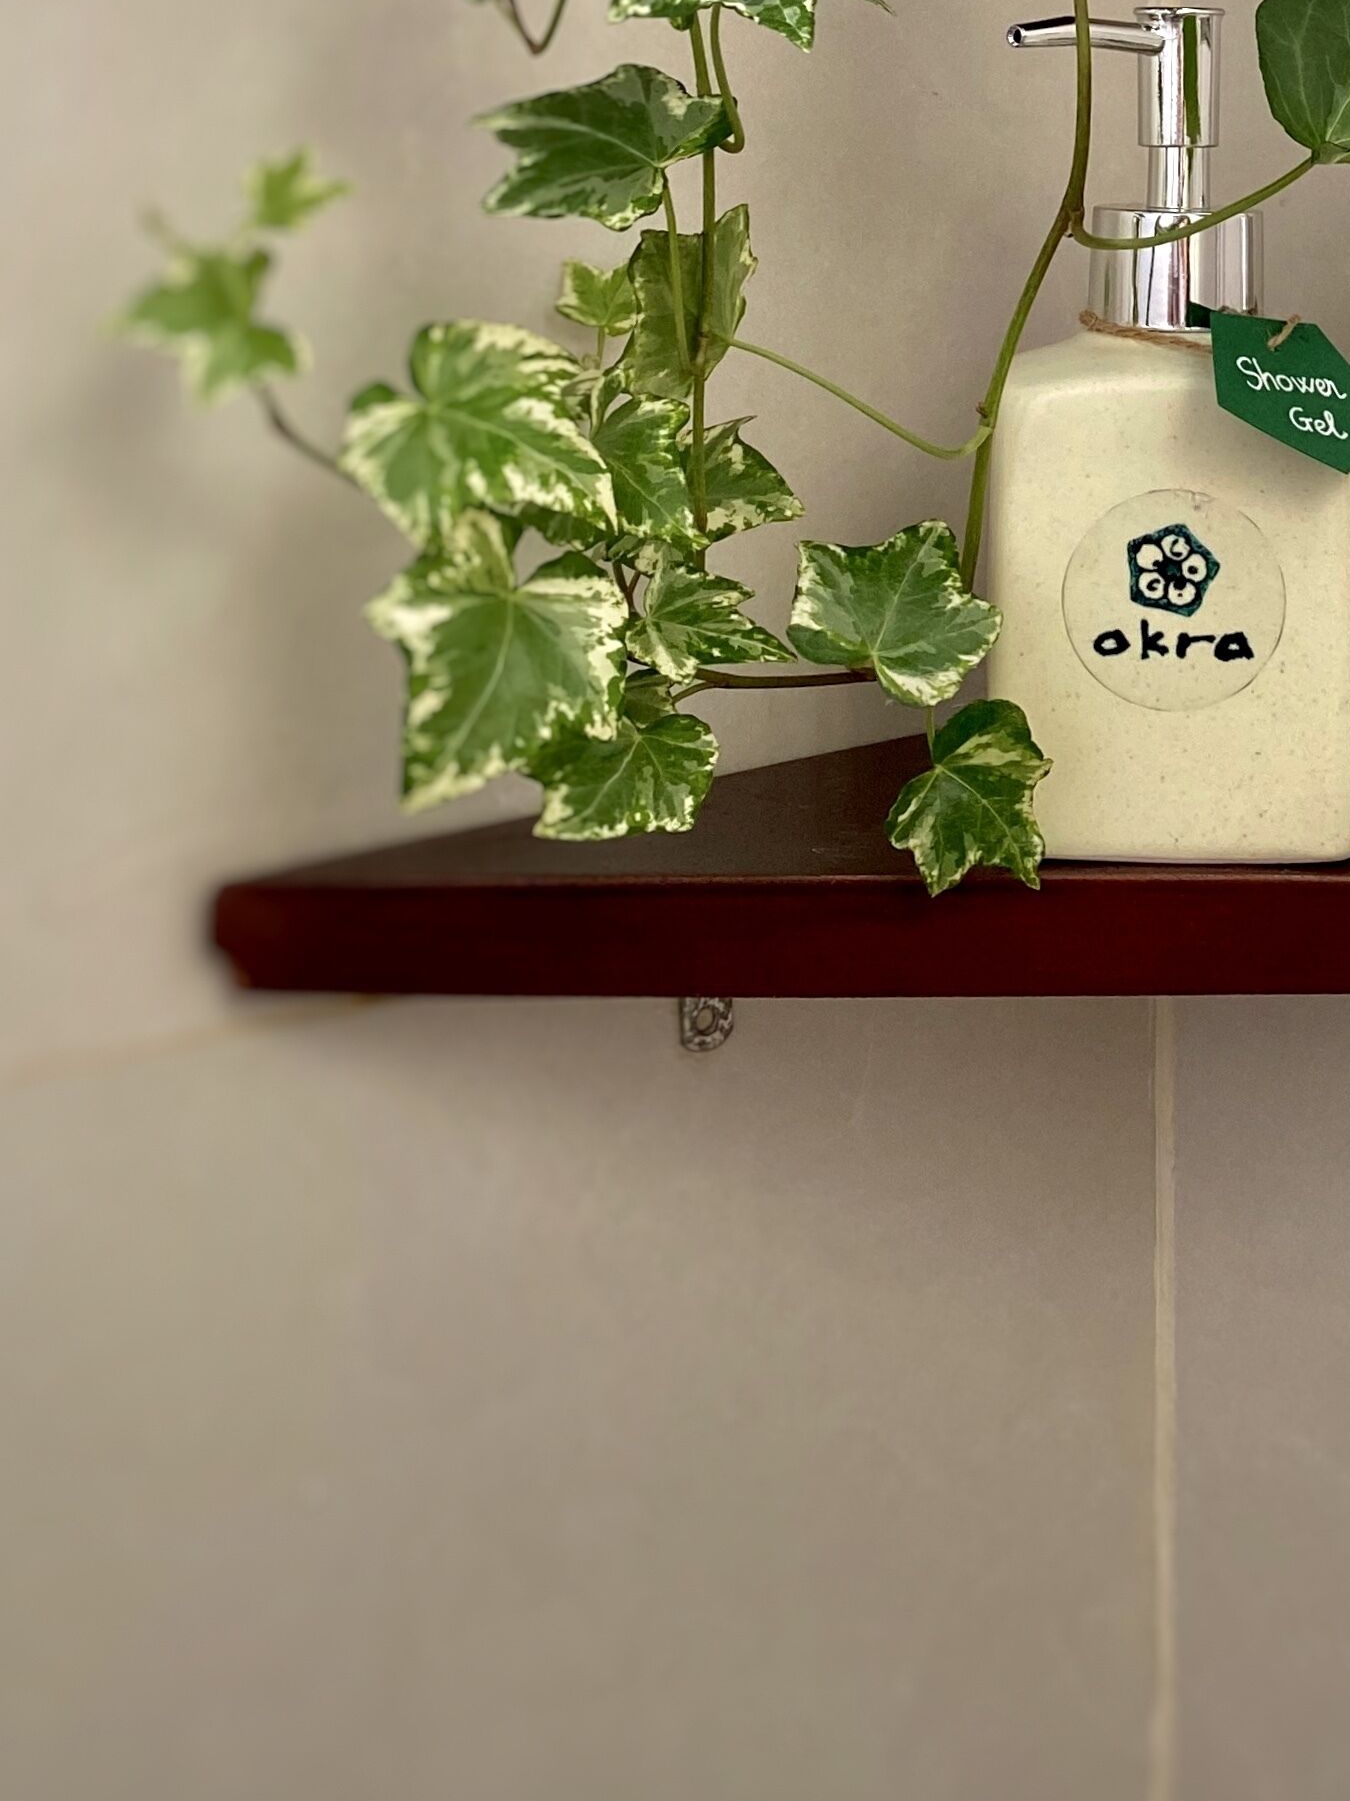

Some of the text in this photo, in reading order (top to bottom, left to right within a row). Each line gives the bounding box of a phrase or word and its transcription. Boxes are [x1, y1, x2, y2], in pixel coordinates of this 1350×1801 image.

[1236, 356, 1347, 400] Shower
[1288, 406, 1349, 440] Gel
[1093, 619, 1255, 662] okra
